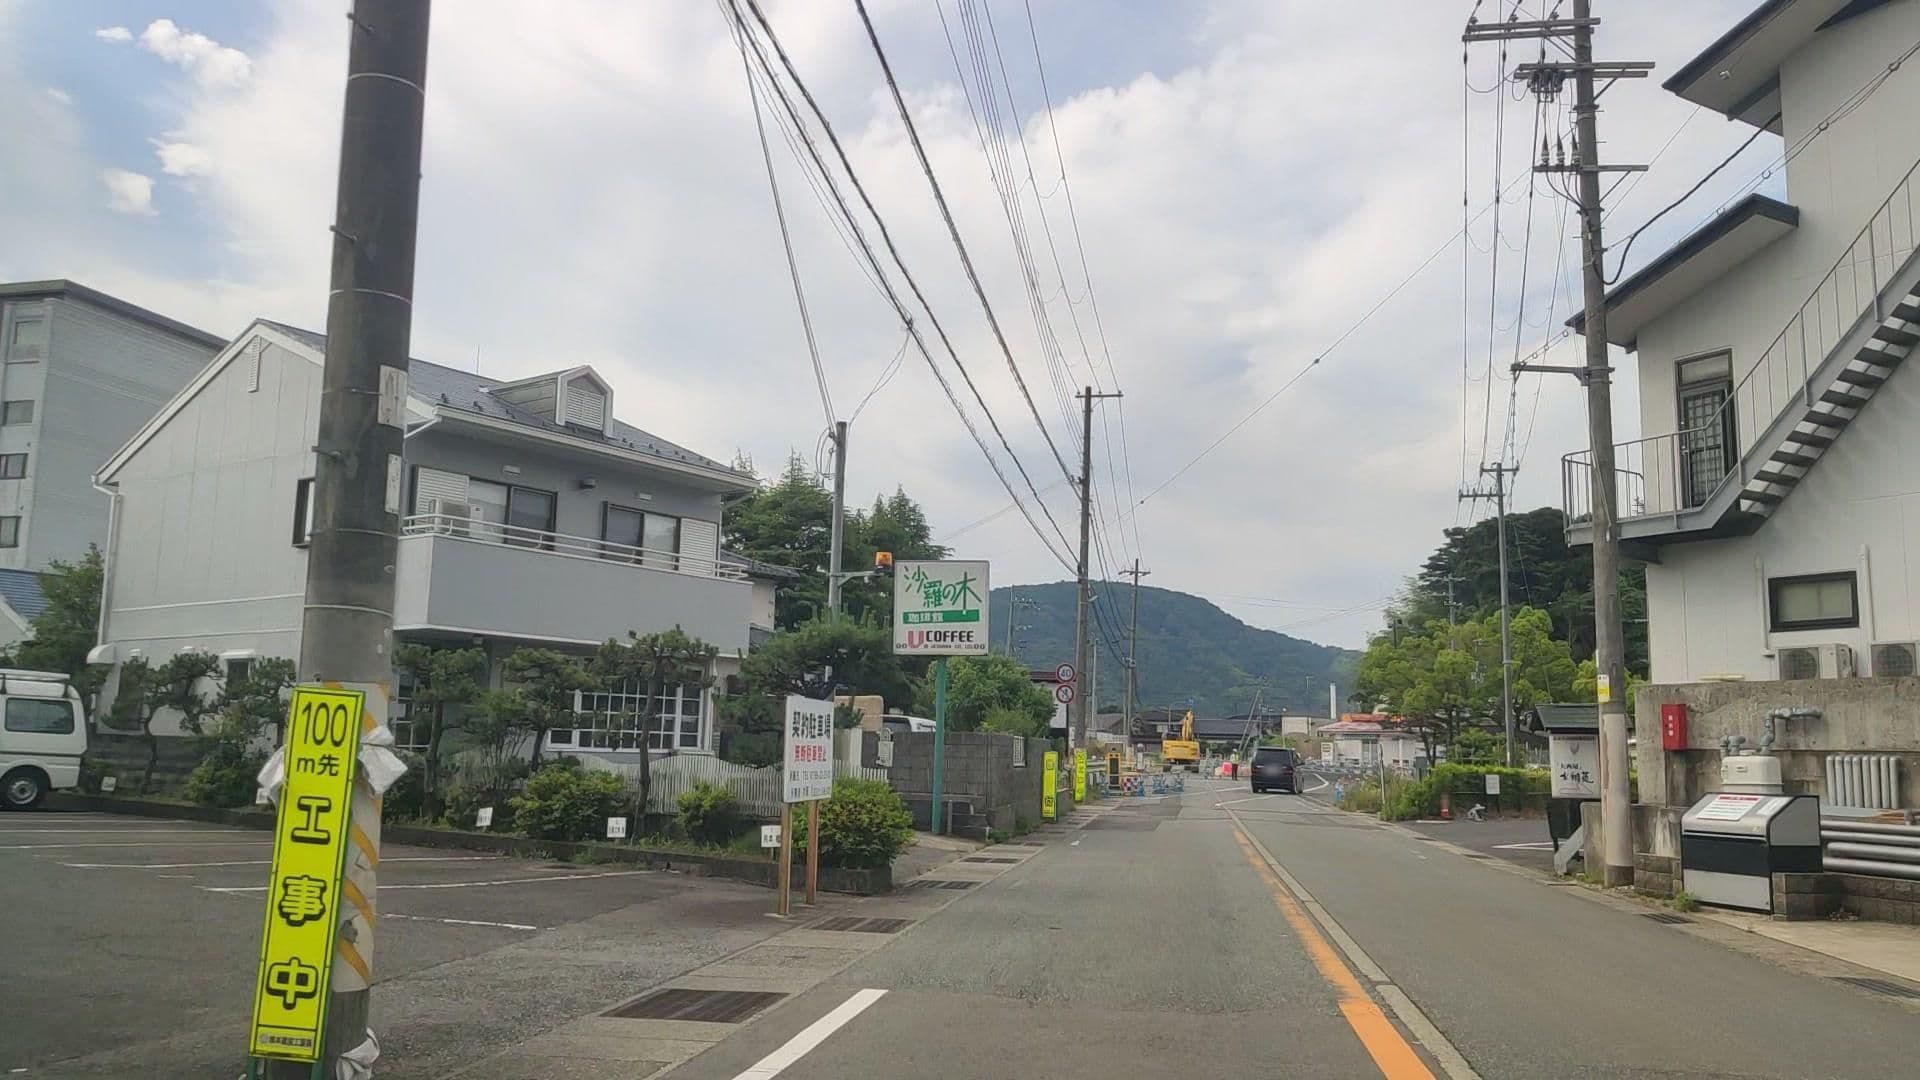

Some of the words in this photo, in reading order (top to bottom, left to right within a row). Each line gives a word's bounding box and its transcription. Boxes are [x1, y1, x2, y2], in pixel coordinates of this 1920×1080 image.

[903, 565, 983, 612] 沙羅の木
[926, 630, 975, 643] COFFEE
[1060, 669, 1072, 678] 40
[301, 700, 348, 748] 100
[296, 753, 340, 778] m先
[265, 795, 332, 1010] 工事中
